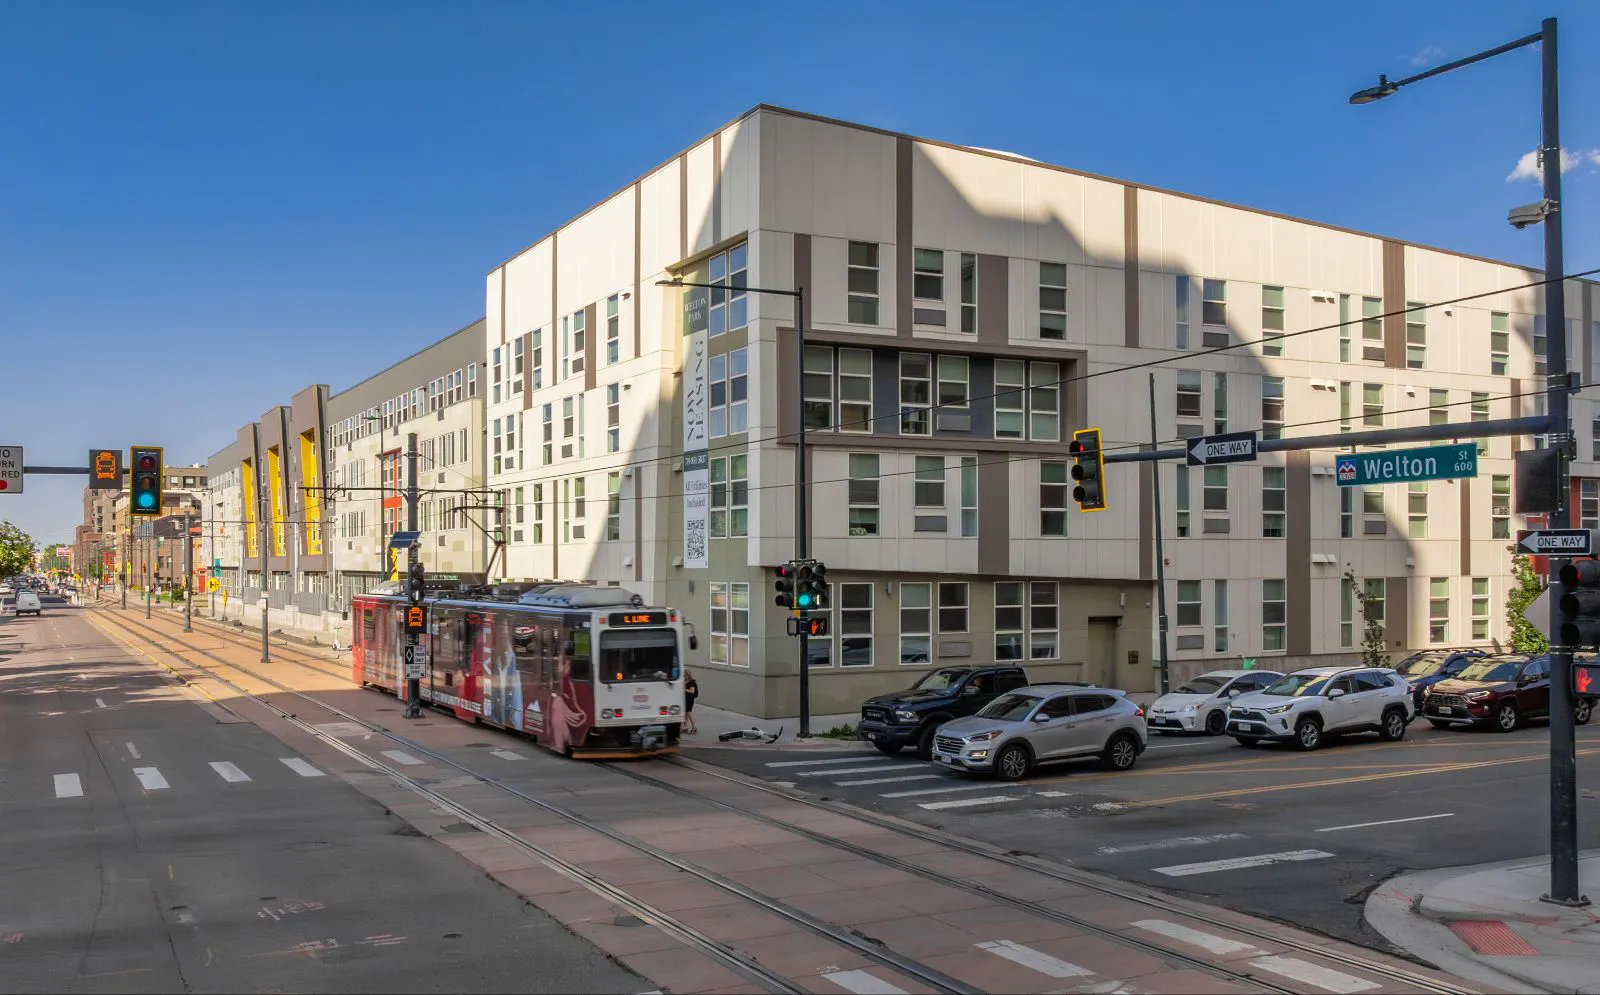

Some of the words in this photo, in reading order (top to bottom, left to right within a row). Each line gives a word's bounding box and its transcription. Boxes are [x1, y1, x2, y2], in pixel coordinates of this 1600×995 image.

[695, 340, 704, 440] LEASING
[687, 390, 695, 441] NOW
[0, 449, 10, 458] O
[1207, 444, 1225, 456] ONE
[1228, 441, 1249, 454] WAY
[1458, 450, 1468, 460] St
[1364, 455, 1437, 480] Welton
[1454, 461, 1473, 472] 600
[1, 470, 20, 478] RED
[1537, 537, 1557, 547] ONE
[1561, 537, 1582, 547] WAY
